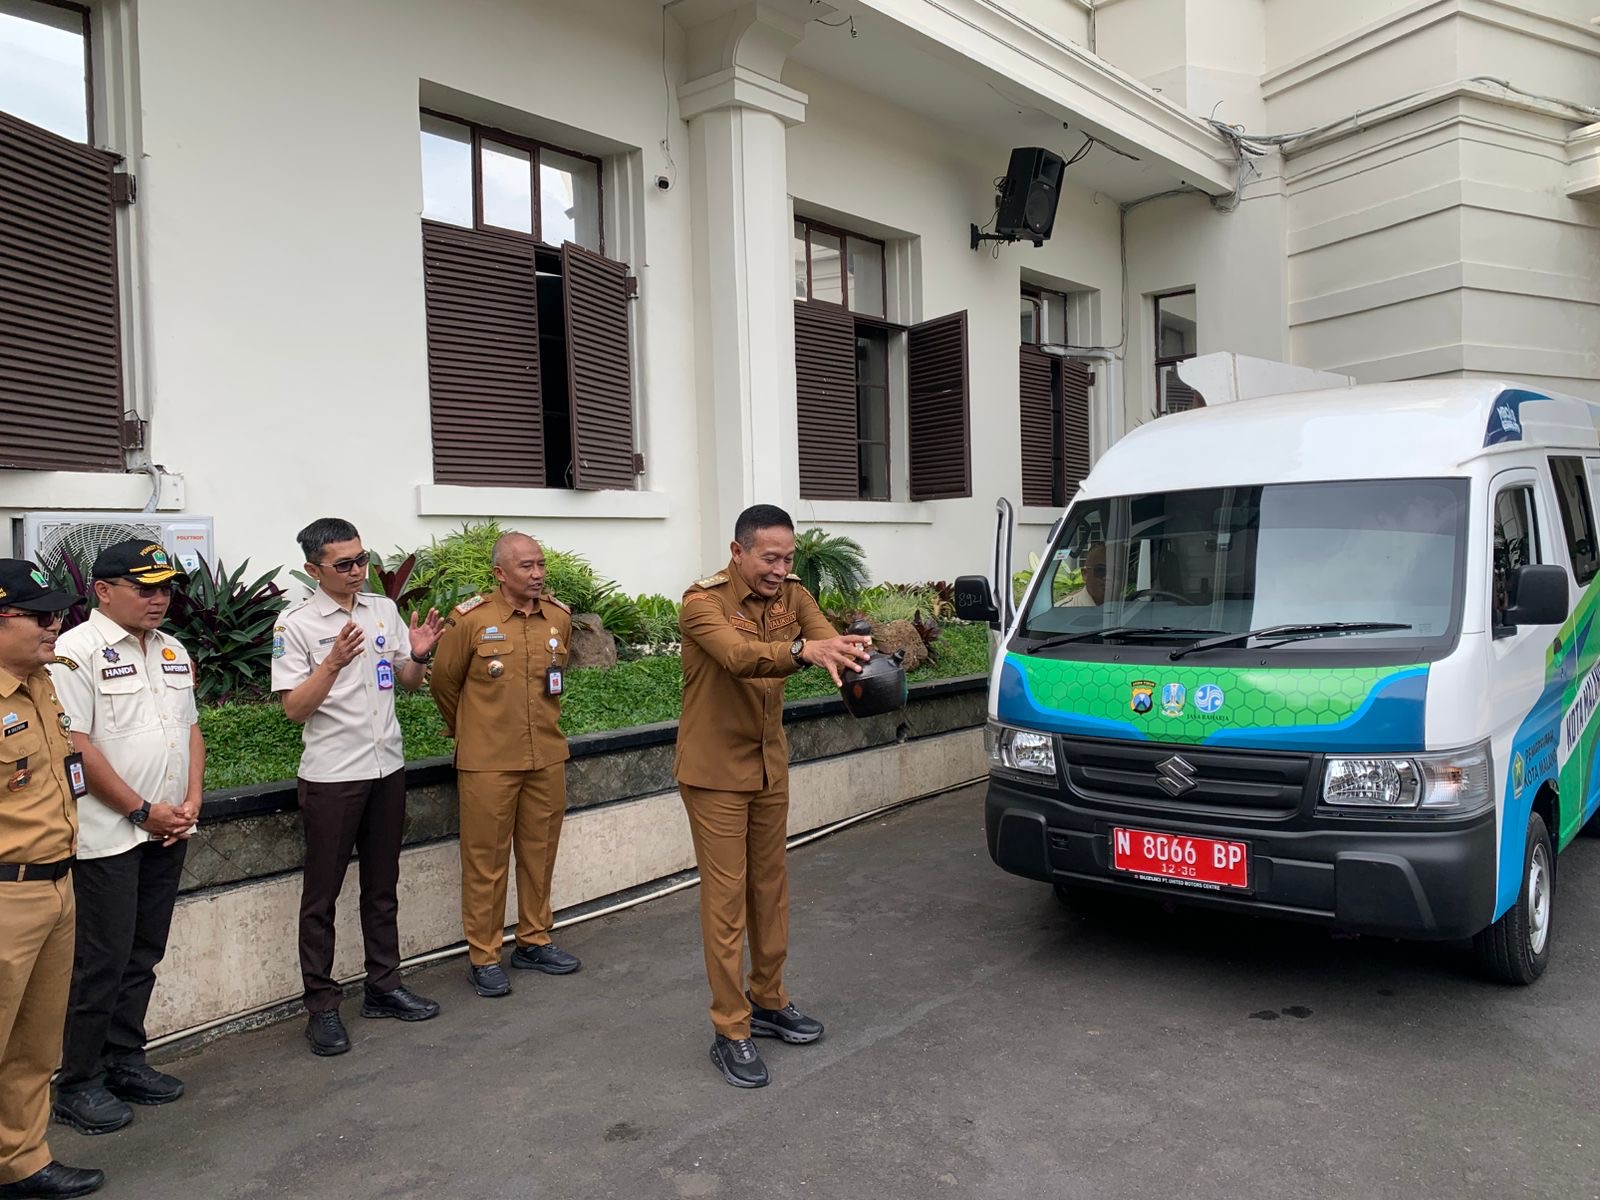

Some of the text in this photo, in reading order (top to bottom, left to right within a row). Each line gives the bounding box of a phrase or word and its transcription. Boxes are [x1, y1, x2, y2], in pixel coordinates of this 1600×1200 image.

[105, 667, 133, 677] HANDI
[1566, 697, 1584, 751] KOTA
[1523, 763, 1539, 788] KOTA
[1117, 831, 1242, 870] N 8066 BP
